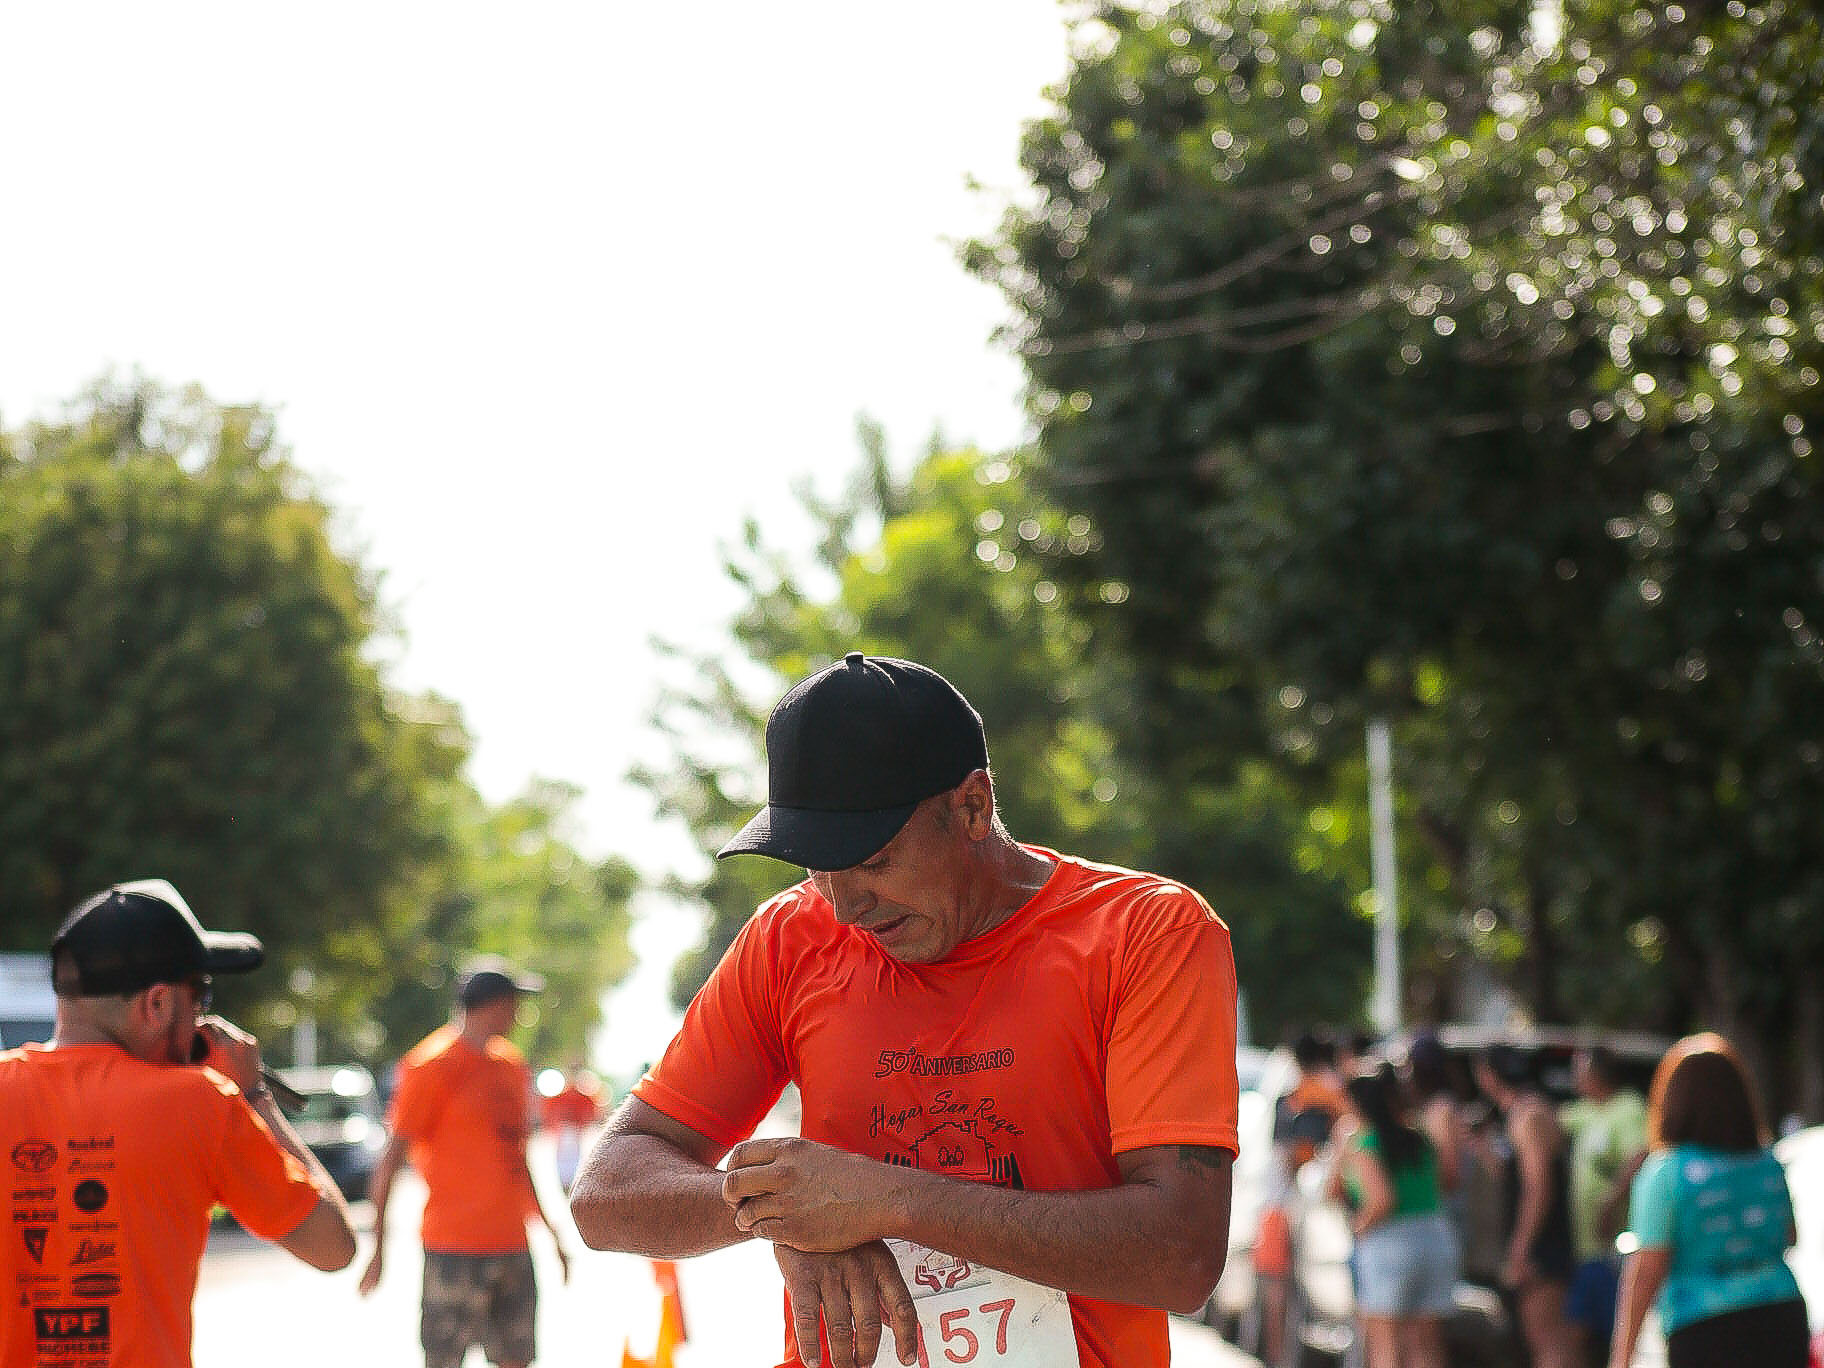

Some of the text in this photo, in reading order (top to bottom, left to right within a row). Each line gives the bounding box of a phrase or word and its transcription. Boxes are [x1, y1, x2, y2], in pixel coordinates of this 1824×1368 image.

[911, 1047, 1015, 1076] ANIVERSARIO
[869, 1089, 1025, 1138] Hogar San Roque
[45, 1312, 101, 1334] YPF
